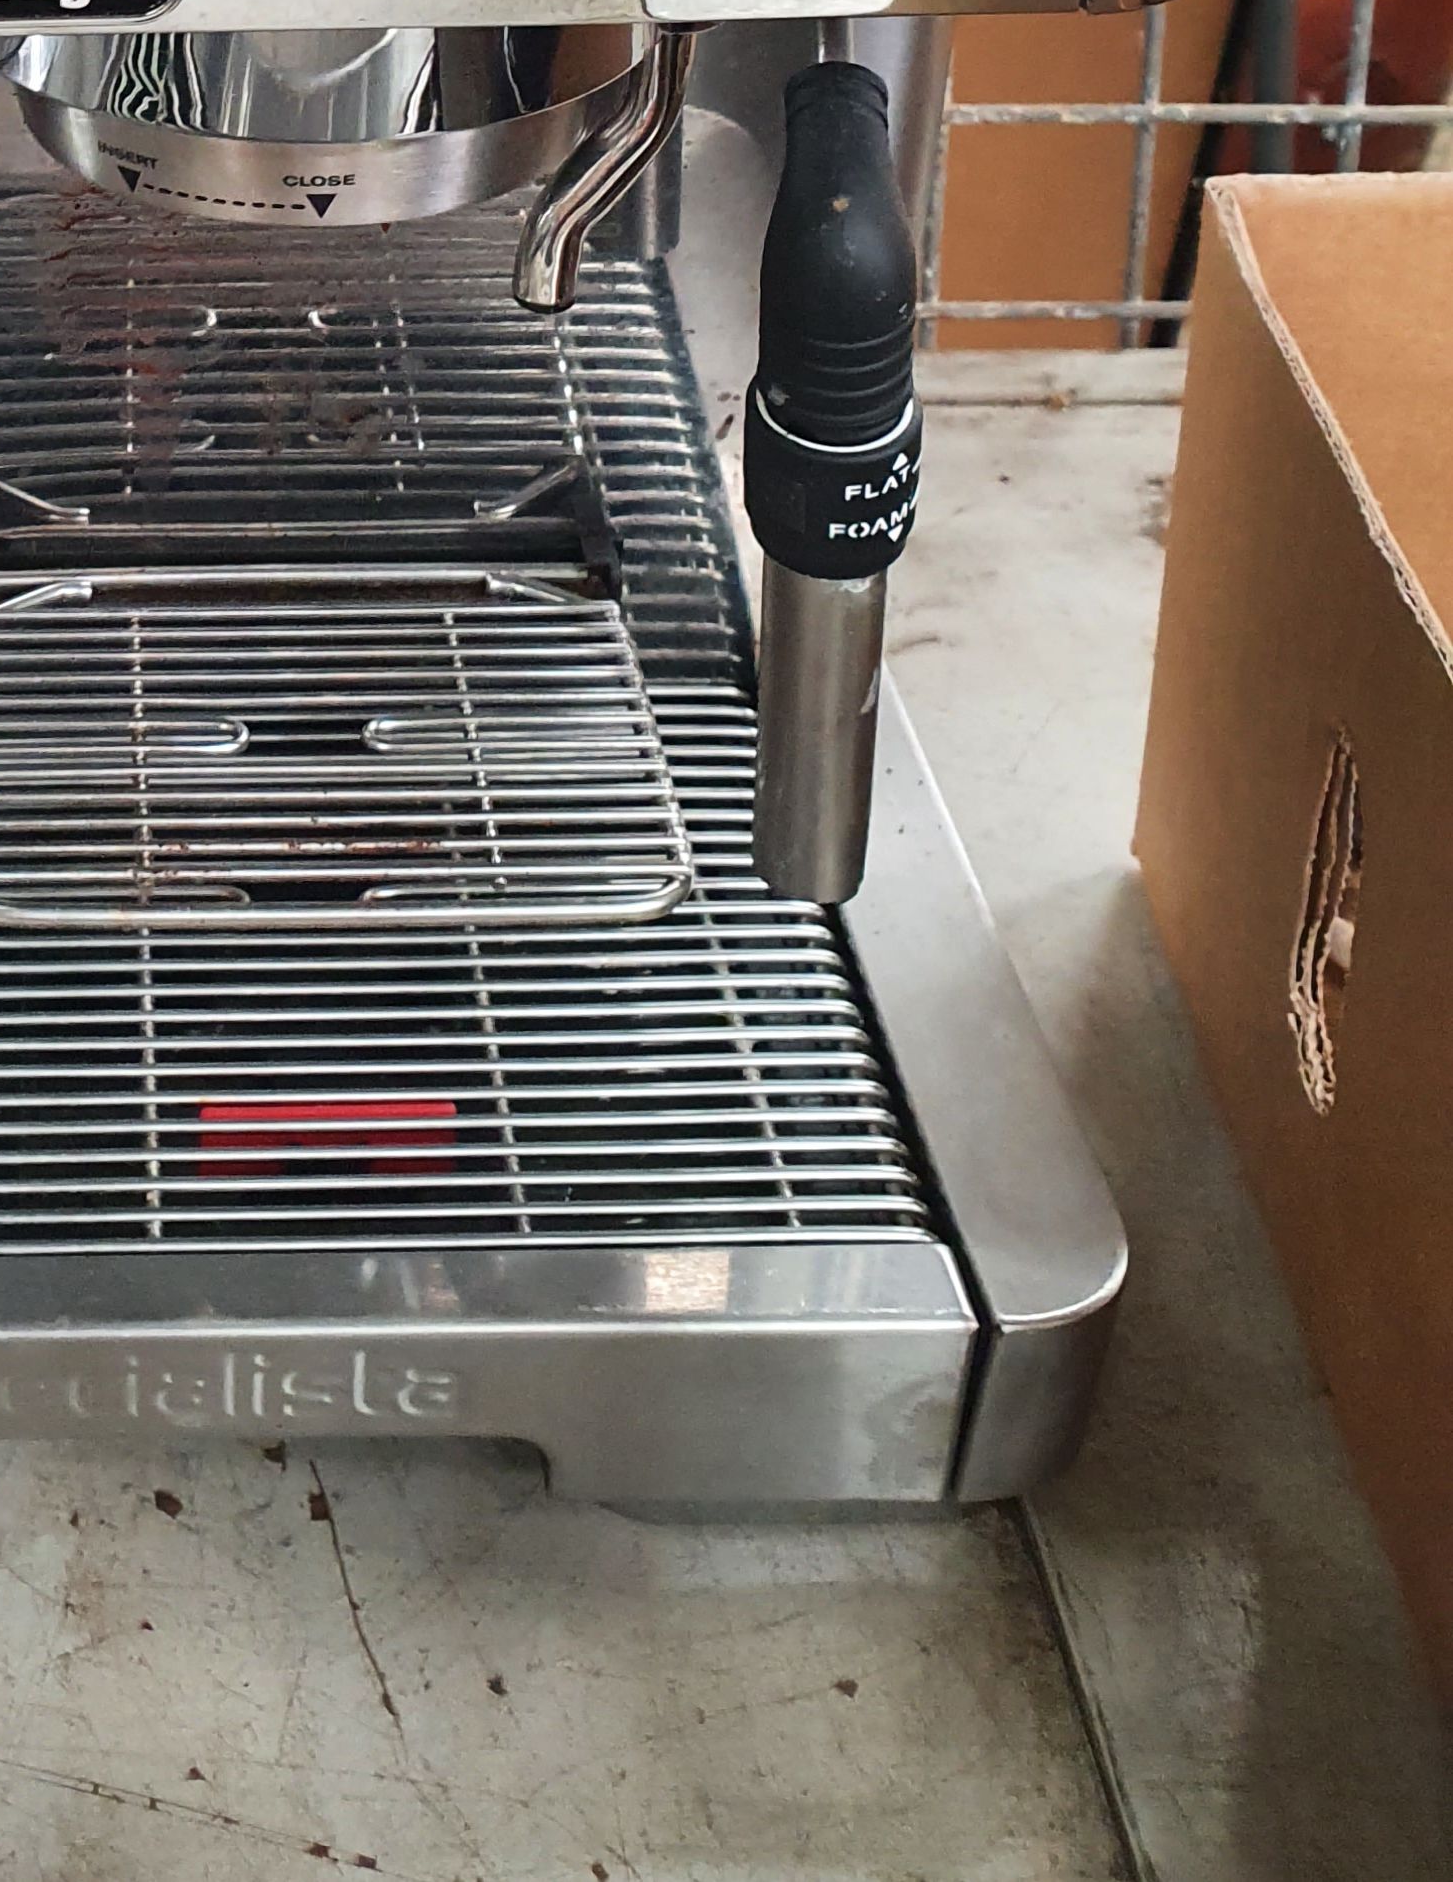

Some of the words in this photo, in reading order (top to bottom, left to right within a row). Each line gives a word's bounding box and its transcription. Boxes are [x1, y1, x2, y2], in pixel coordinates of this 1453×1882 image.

[282, 173, 357, 188] CLOSE
[844, 464, 910, 501] FLAT
[828, 501, 908, 539] FOAM
